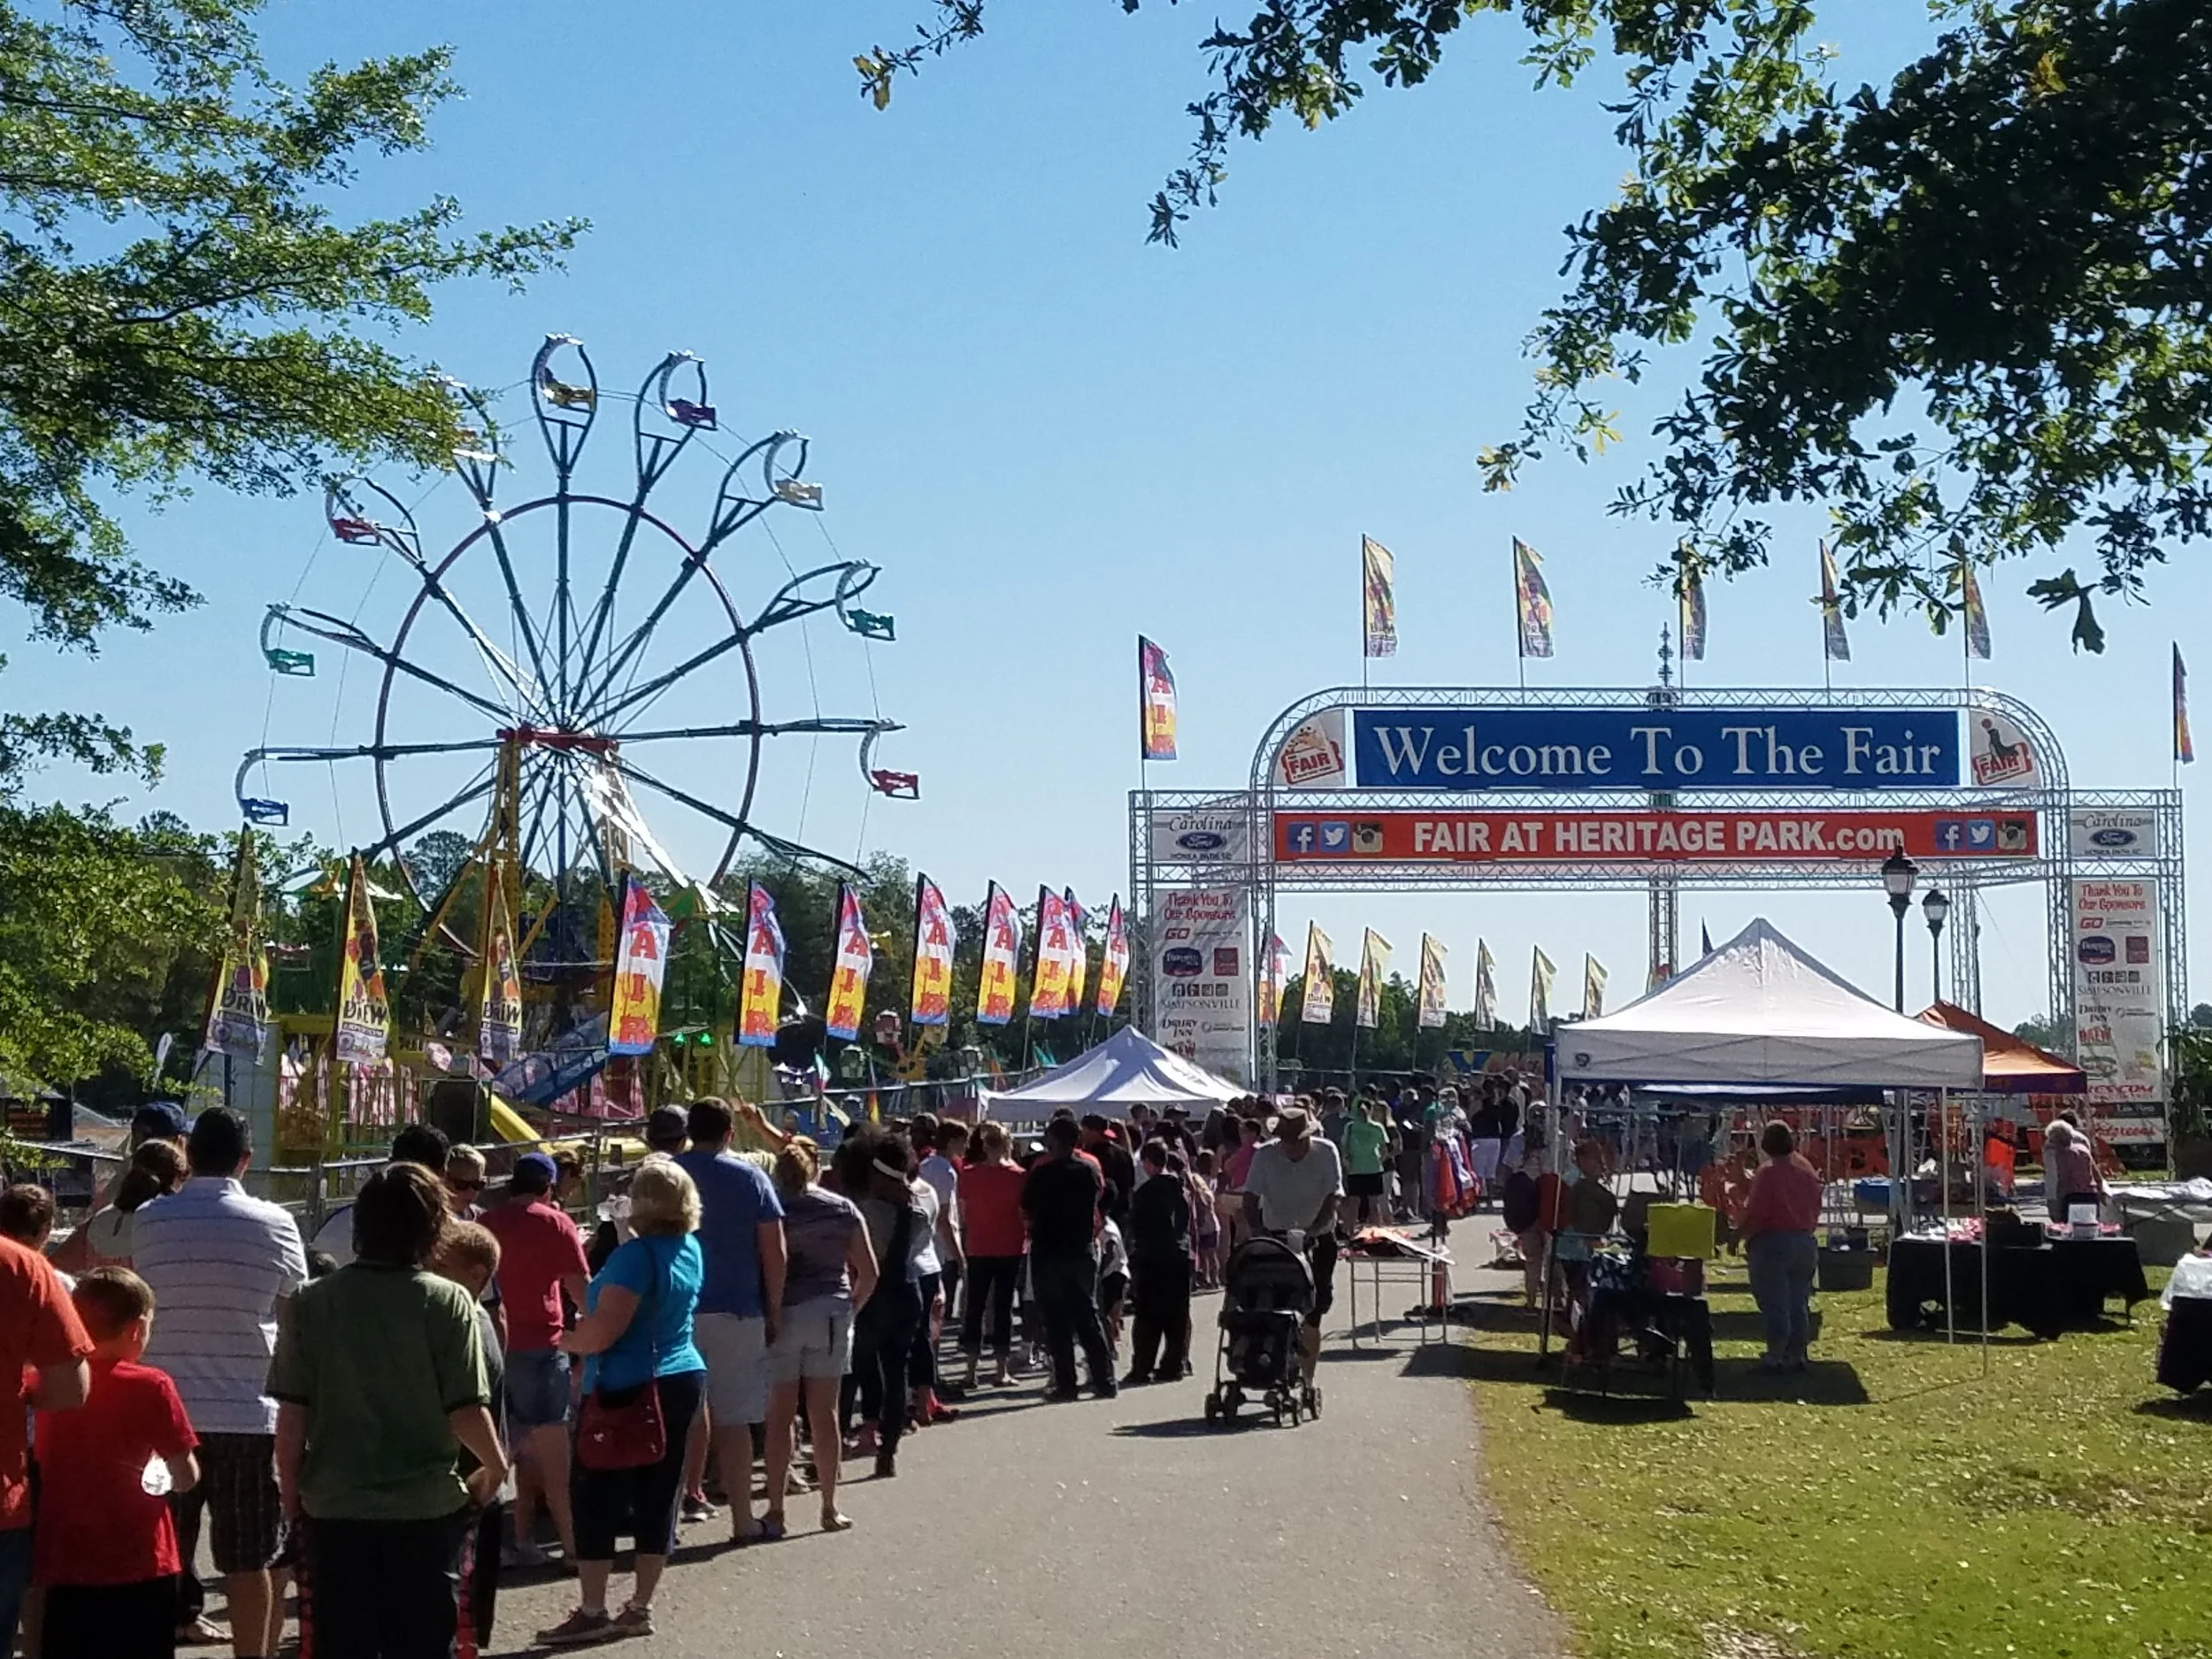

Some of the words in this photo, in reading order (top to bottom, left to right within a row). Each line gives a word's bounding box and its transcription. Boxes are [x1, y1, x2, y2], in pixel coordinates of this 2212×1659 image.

[1373, 726, 1612, 776] Welcome
[1630, 726, 1704, 775] To
[1721, 726, 1824, 775] The
[1839, 726, 1942, 775] Fair
[1288, 753, 1331, 774] FAIR
[1980, 754, 2019, 776] FAIR
[1169, 815, 1233, 831] Carolina
[2084, 812, 2141, 828] Carolina
[1414, 822, 1491, 852] FAIR
[1500, 822, 1543, 852] AT
[1555, 821, 1726, 852] HERITAGE
[1736, 819, 1905, 851] PARK.com
[2082, 884, 2111, 896] Thank
[2113, 883, 2131, 896] You
[2133, 883, 2144, 896] To
[1168, 891, 1198, 906] Thank
[1199, 891, 1219, 906] You
[1222, 893, 1233, 906] To
[2078, 897, 2098, 910] Our
[1164, 907, 1184, 920] Our
[2080, 917, 2104, 929] GO
[1164, 927, 1191, 939] GO
[1160, 999, 1240, 1009] SIMPSONVILLE
